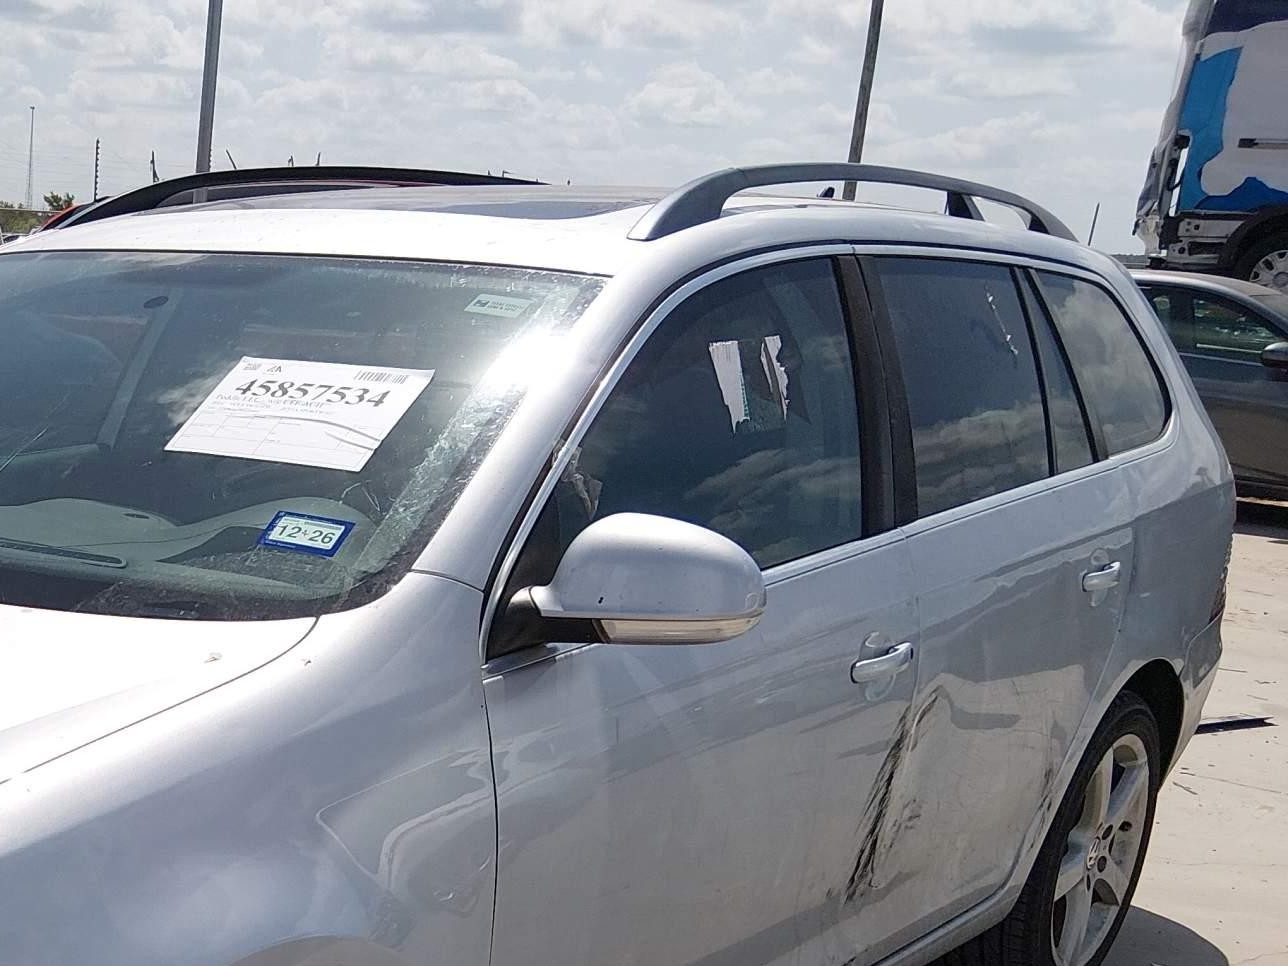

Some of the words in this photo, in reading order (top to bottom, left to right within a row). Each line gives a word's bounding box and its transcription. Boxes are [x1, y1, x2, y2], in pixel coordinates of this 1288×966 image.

[235, 378, 392, 407] 45857534
[278, 524, 302, 539] 12
[308, 529, 336, 544] 26
